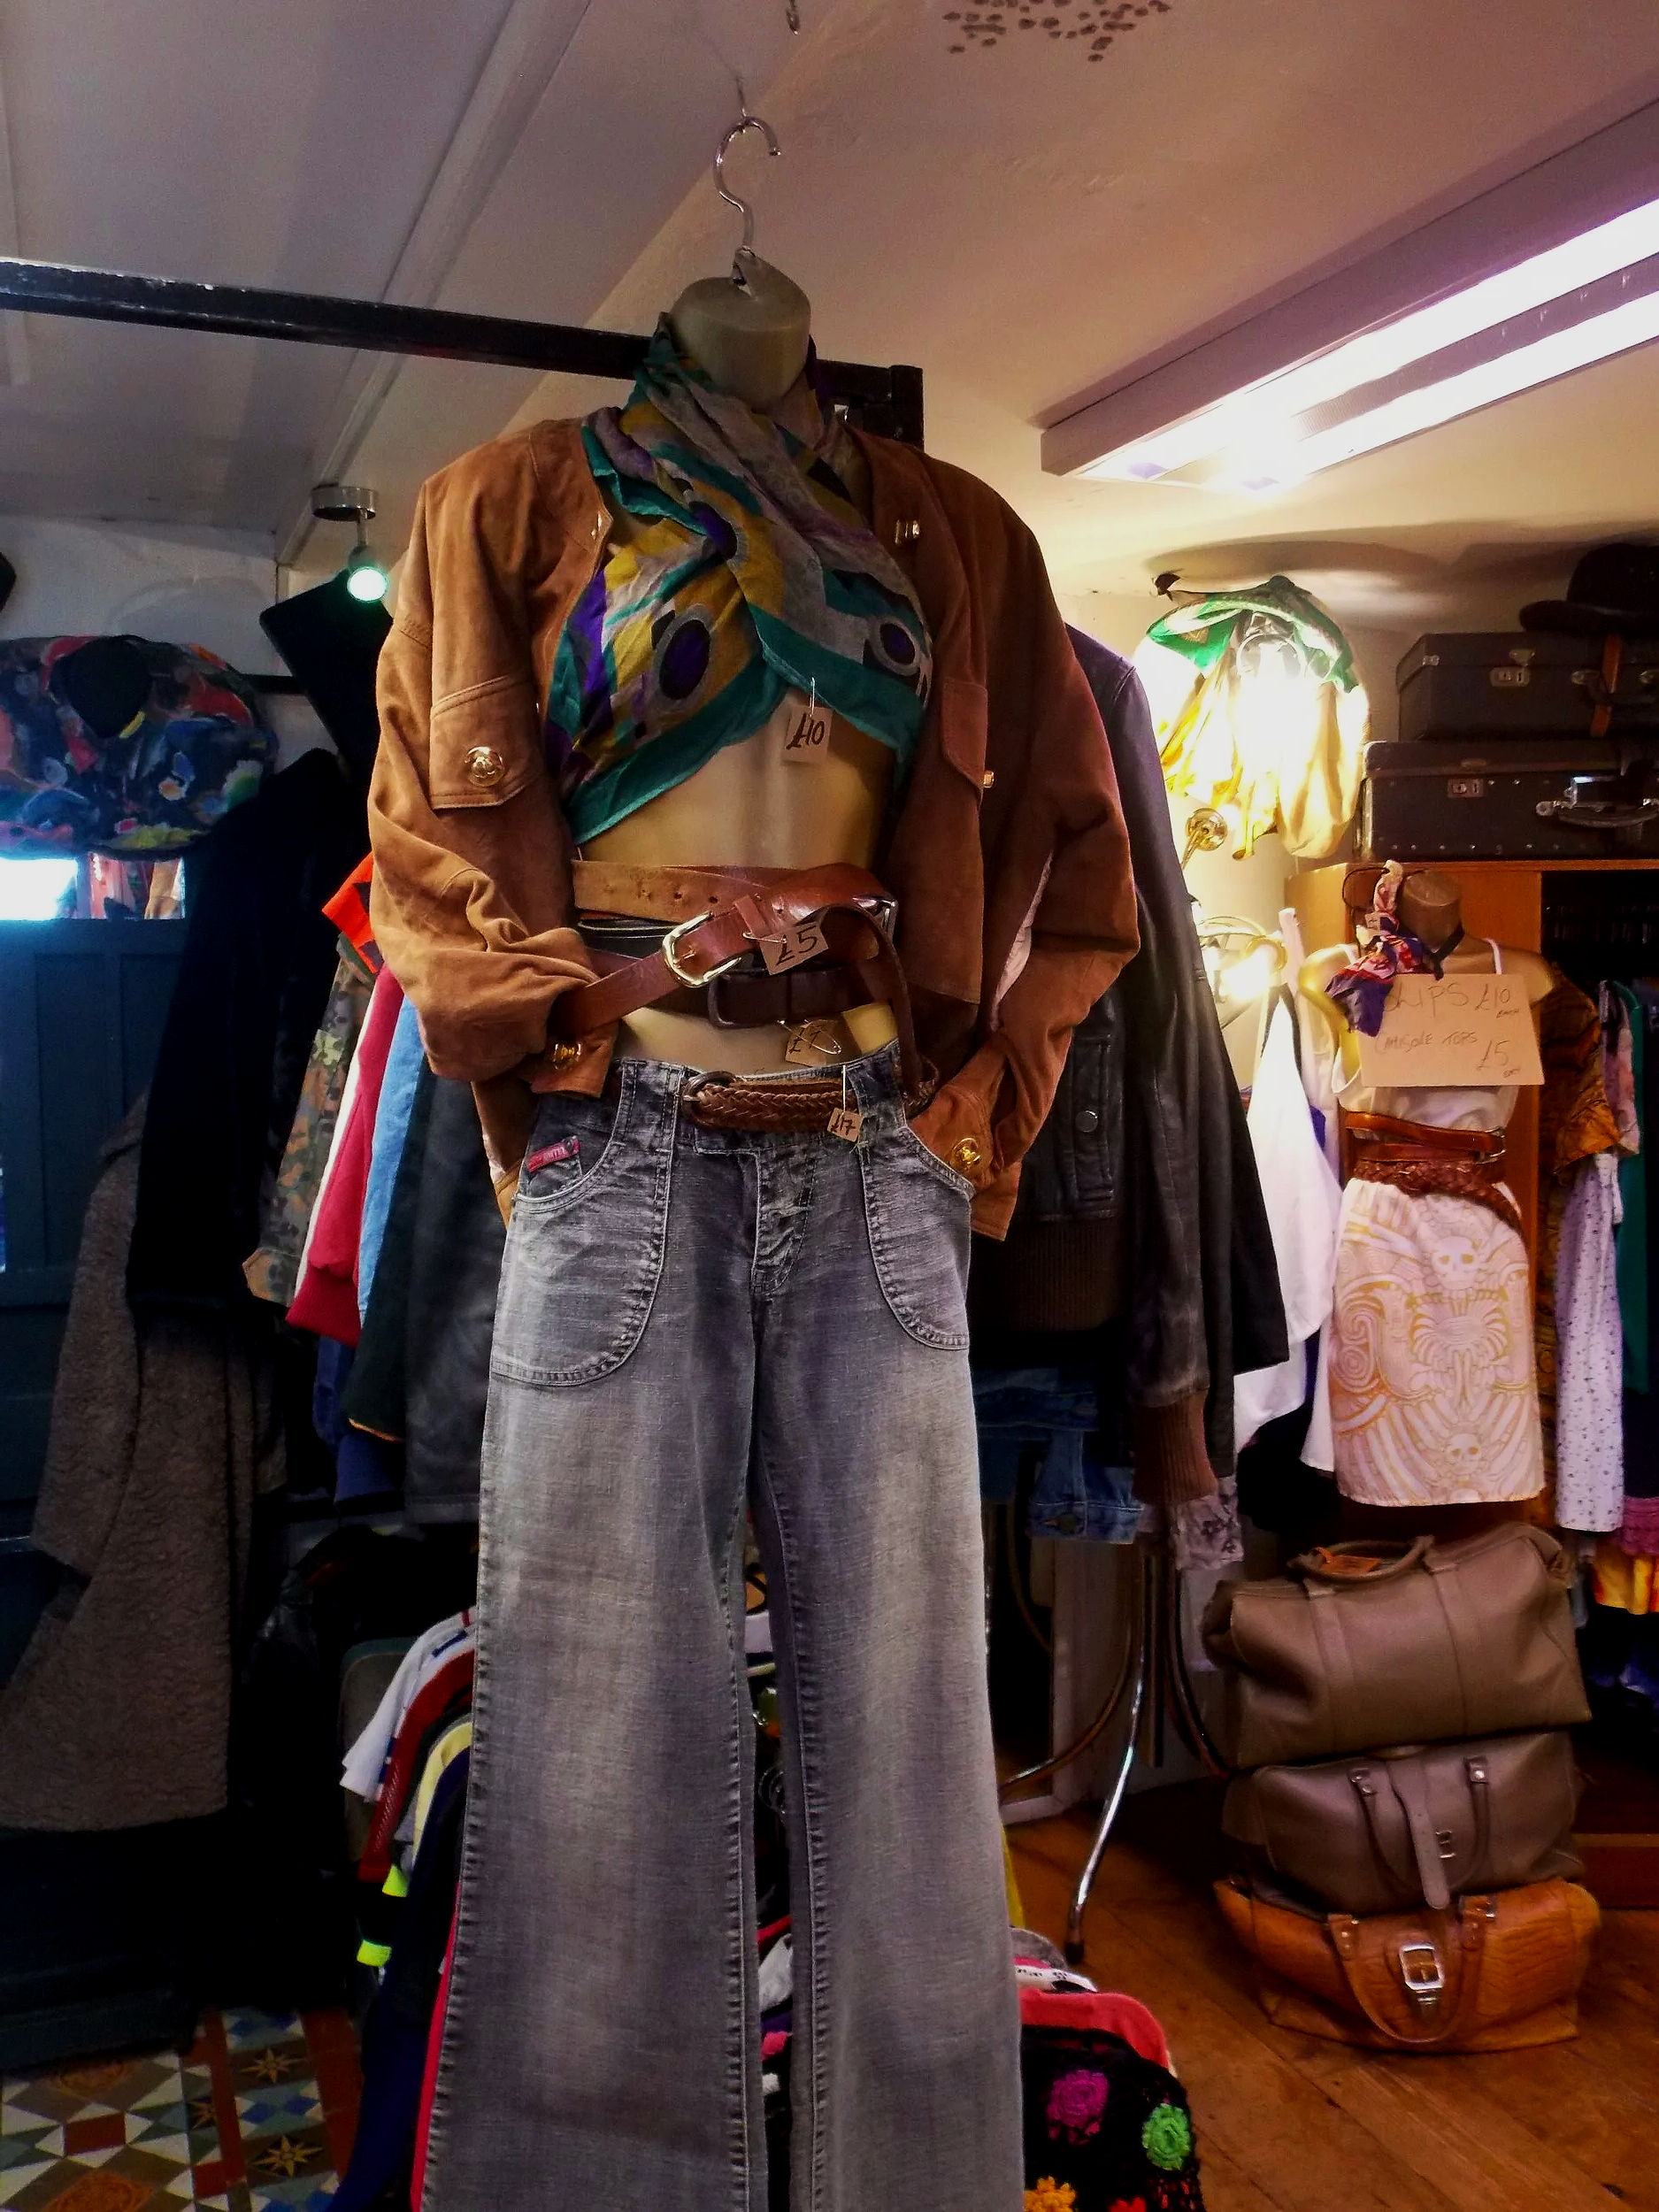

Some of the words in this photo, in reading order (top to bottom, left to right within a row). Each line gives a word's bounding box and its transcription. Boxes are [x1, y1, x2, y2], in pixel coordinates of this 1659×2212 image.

[786, 711, 826, 750] £10
[776, 925, 818, 965] £5
[1475, 982, 1511, 1011] £10
[1440, 1029, 1479, 1046] TOPS
[1476, 1040, 1510, 1071] £5
[830, 1114, 856, 1136] £17
